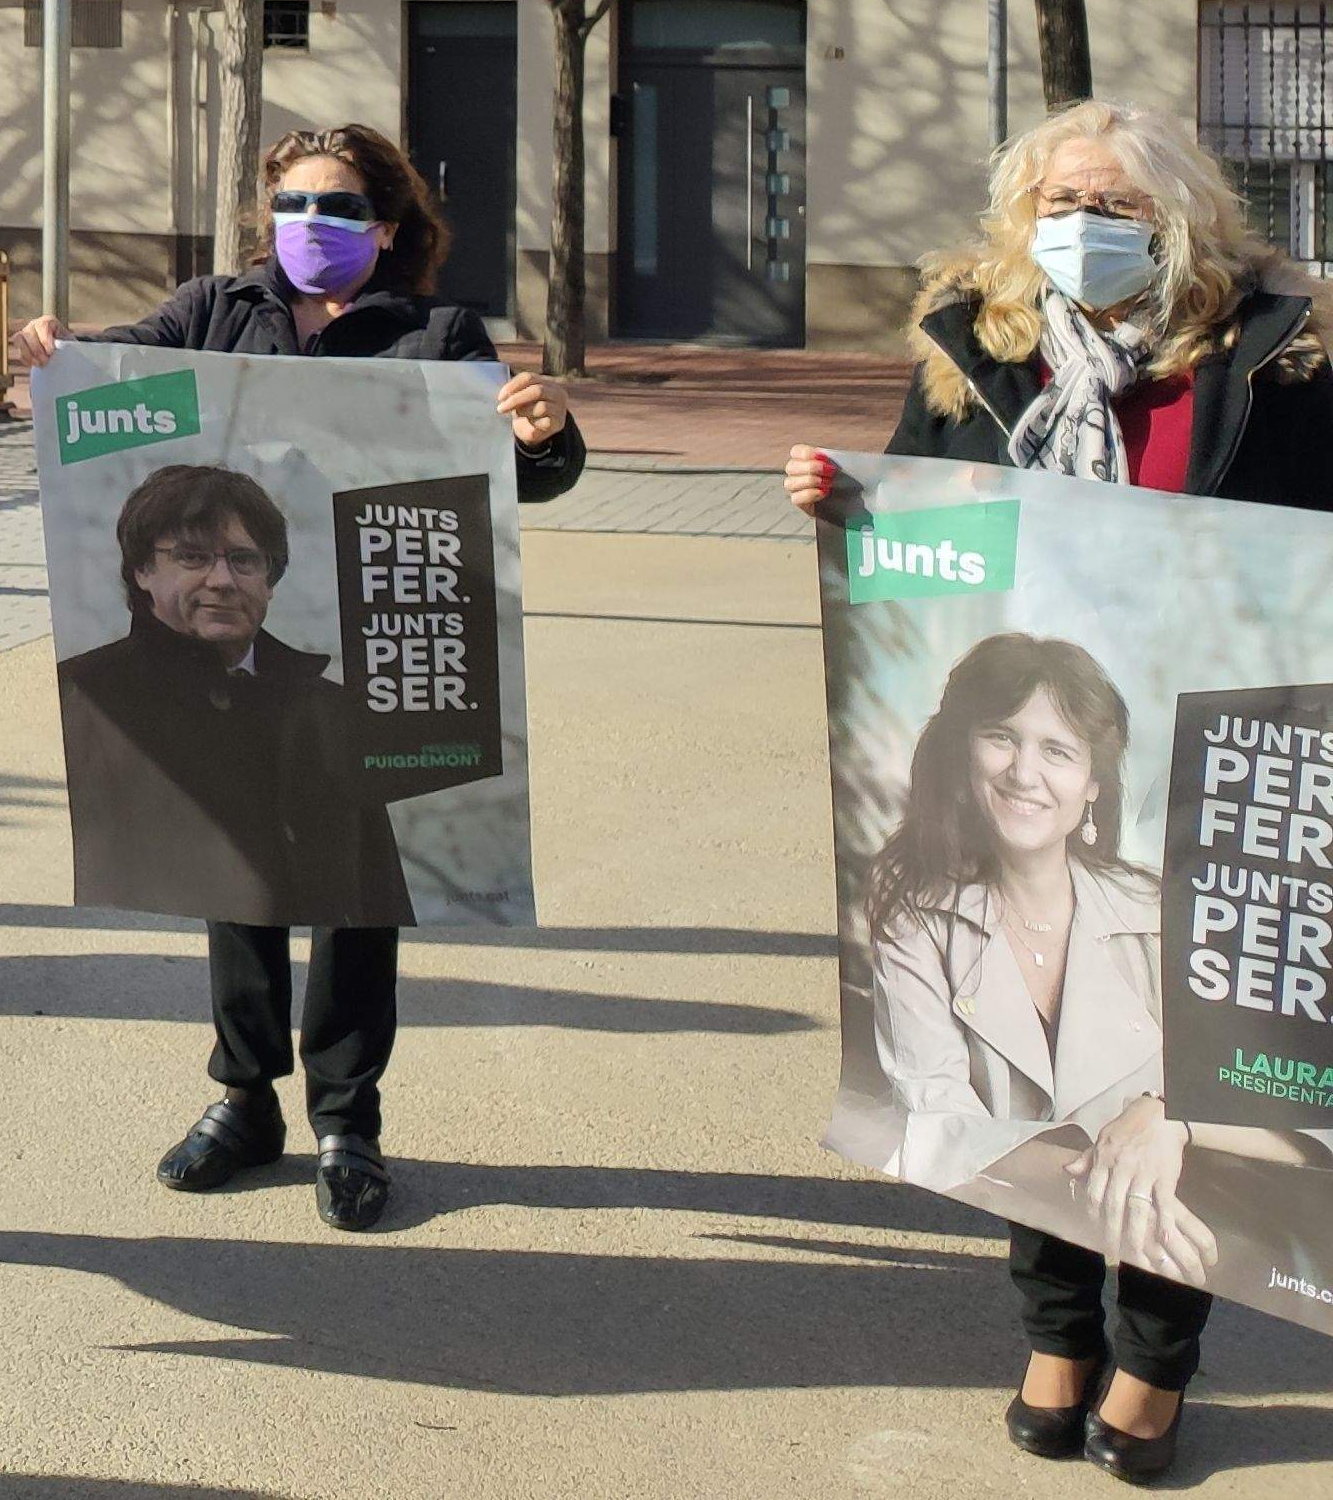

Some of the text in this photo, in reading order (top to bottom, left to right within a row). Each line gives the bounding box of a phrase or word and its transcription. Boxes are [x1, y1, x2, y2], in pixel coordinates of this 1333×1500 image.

[67, 401, 176, 444] junts
[355, 504, 459, 531] JUNTS
[359, 527, 463, 567] PER
[859, 524, 986, 585] junts
[362, 566, 471, 604] FER.
[362, 612, 464, 636] JUNTS
[366, 638, 468, 674] PER
[367, 676, 478, 713] SER.
[365, 754, 482, 770] PUIGDEMONT
[1203, 745, 1333, 817] PER
[1192, 862, 1333, 914] JUNTS
[1192, 894, 1333, 969] PER
[1187, 948, 1333, 1024] SER
[1235, 1048, 1333, 1088] LAURA
[1268, 1267, 1333, 1304] junts.c
